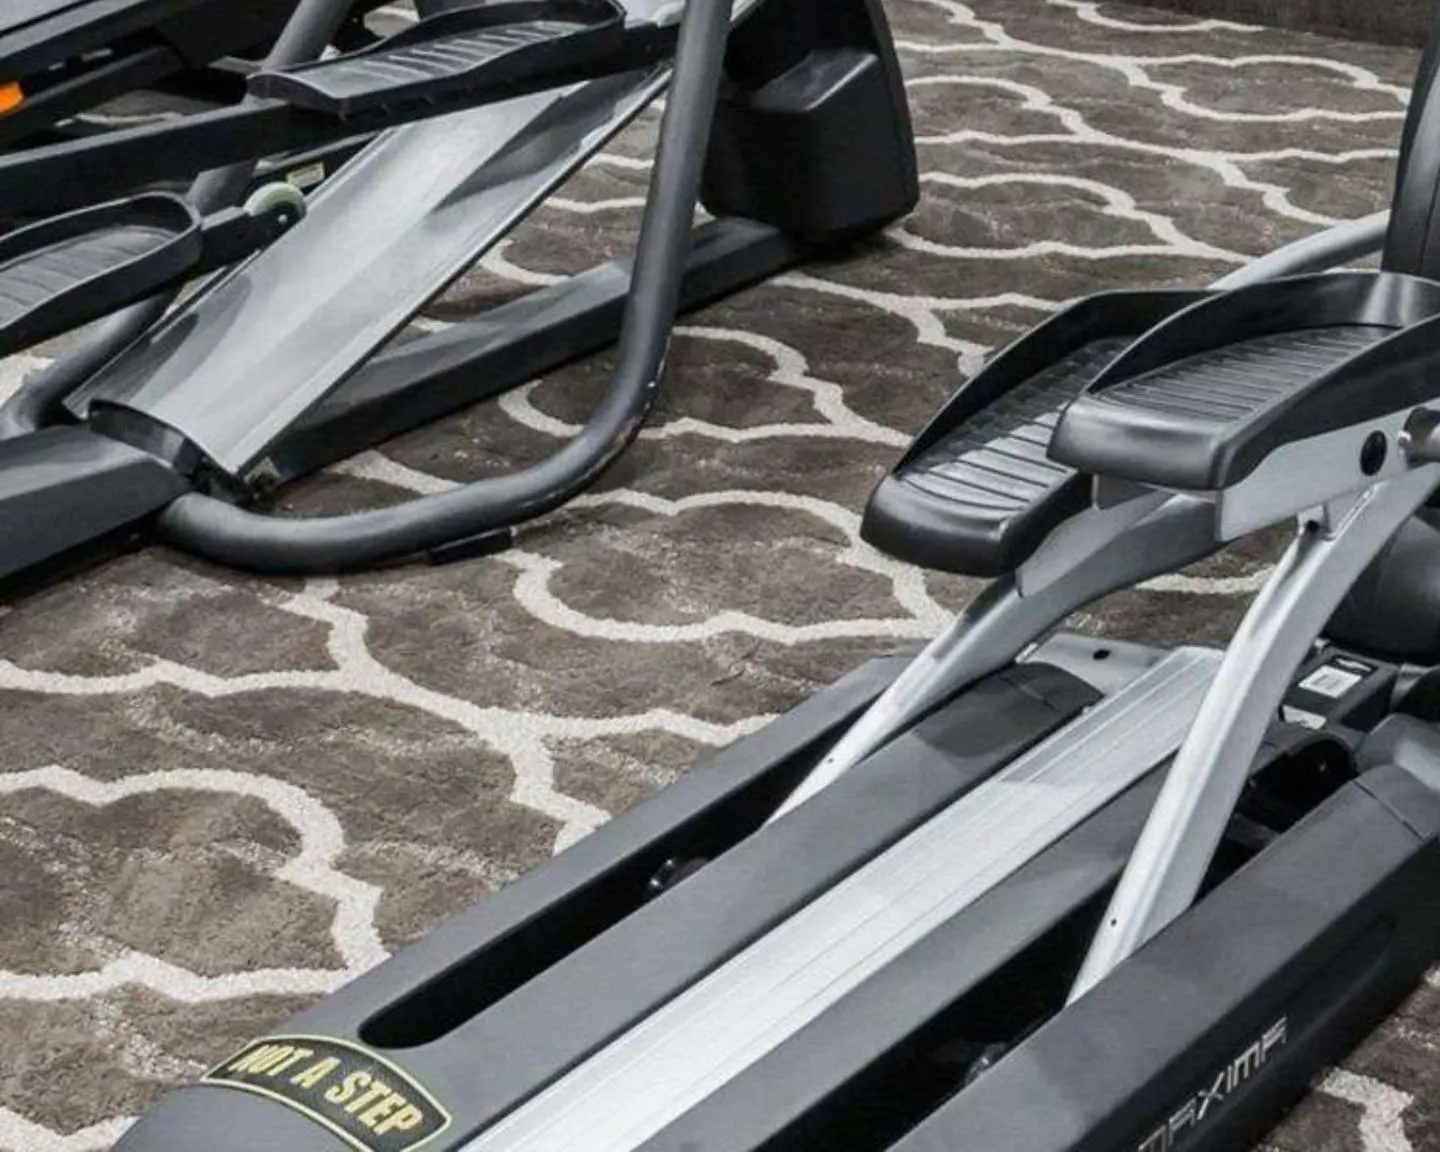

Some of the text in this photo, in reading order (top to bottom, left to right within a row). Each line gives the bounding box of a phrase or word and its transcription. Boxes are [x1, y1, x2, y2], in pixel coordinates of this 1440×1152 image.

[227, 1044, 423, 1136] NOT A STEP
